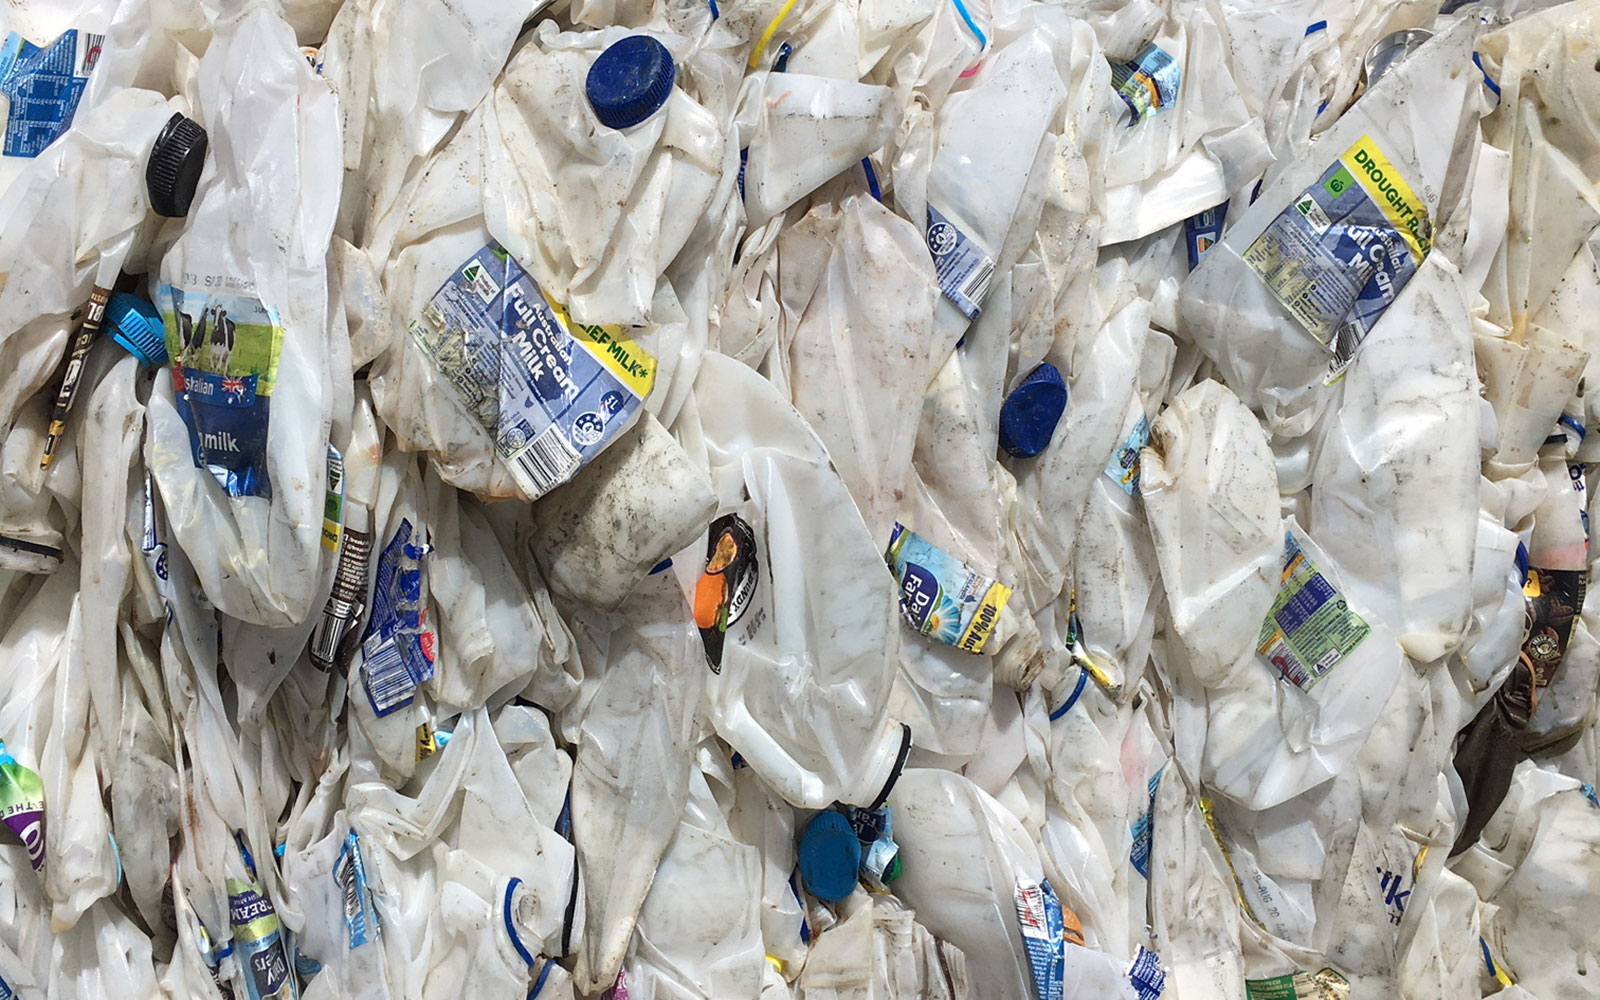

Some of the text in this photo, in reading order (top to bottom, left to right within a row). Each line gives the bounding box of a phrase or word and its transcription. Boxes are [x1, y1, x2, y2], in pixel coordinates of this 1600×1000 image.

[1352, 148, 1413, 223] DROUGHT
[1345, 223, 1375, 251] ull
[503, 281, 538, 328] Full
[529, 327, 582, 404] Cream
[510, 330, 546, 382] Milk
[605, 394, 619, 411] 3L
[205, 431, 240, 453] milk
[974, 603, 997, 633] 100%
[7, 801, 33, 814] THE
[1257, 884, 1273, 905] AUG
